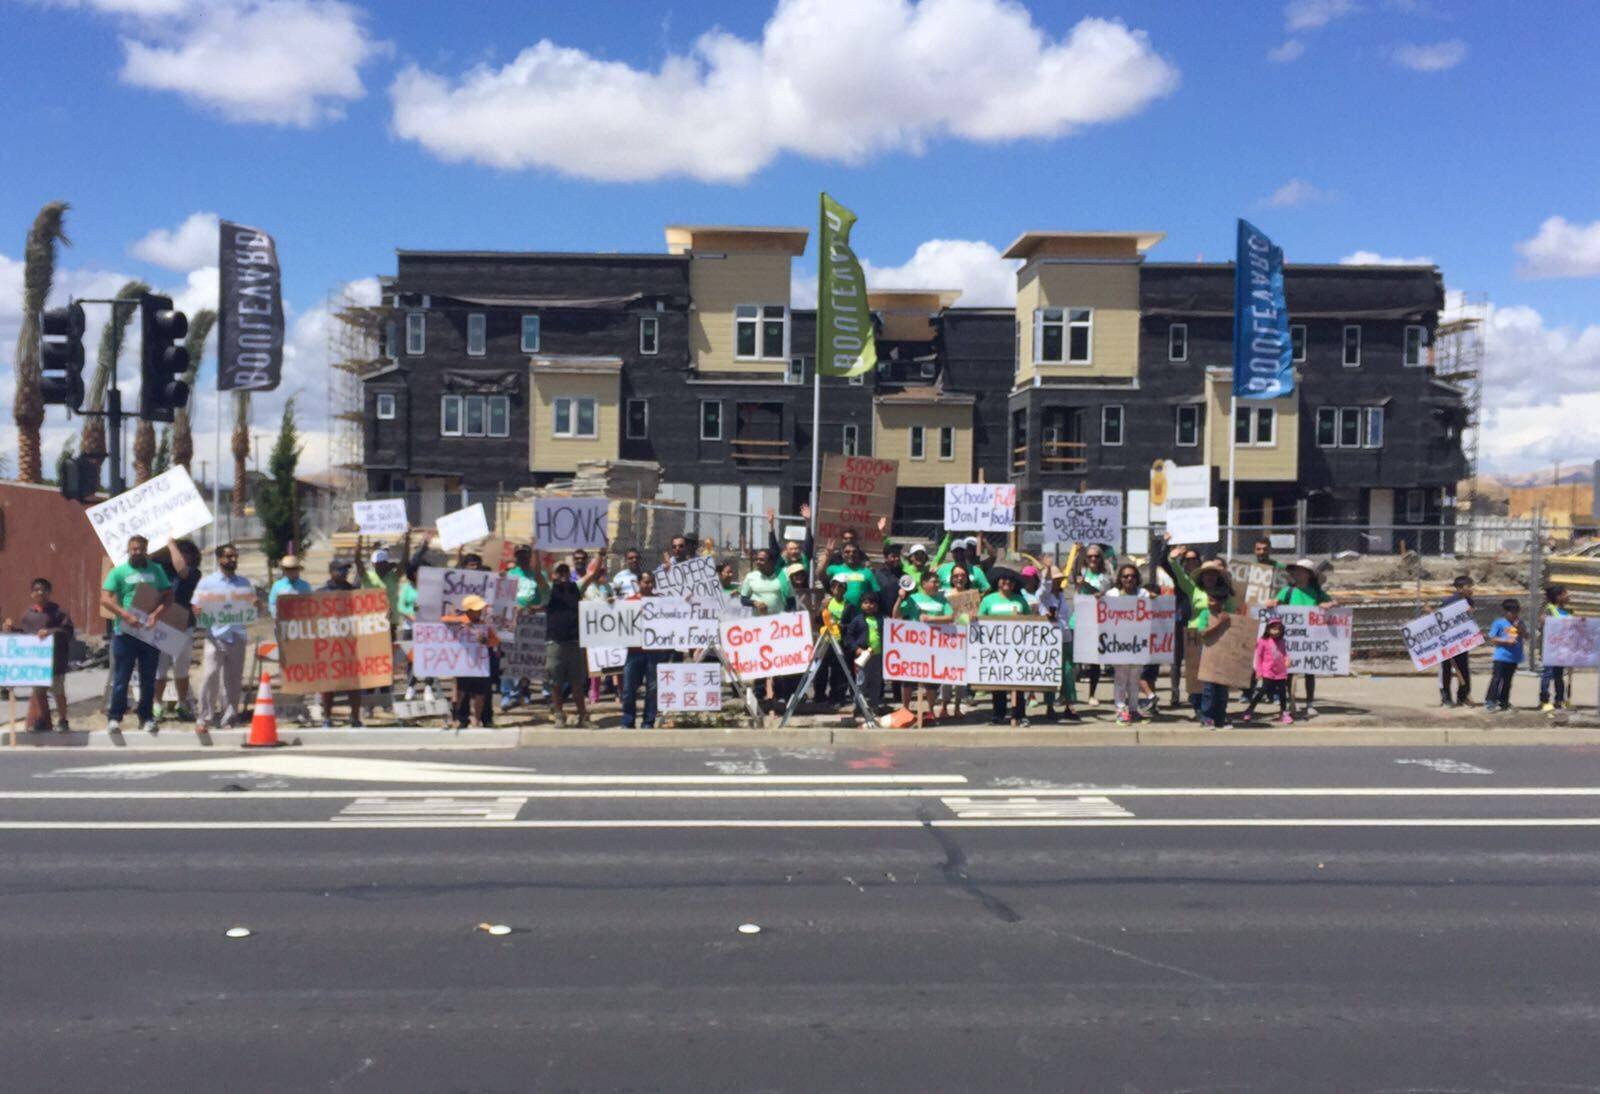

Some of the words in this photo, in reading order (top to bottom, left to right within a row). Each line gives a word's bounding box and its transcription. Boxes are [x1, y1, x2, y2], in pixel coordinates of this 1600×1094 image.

[839, 473, 875, 493] KIDS
[1048, 495, 1118, 508] DEVELOPERS
[1066, 508, 1093, 519] OWE
[535, 505, 609, 544] HONK
[1058, 528, 1114, 542] SCHOOLS
[322, 592, 388, 617] SCHOOLS
[279, 619, 315, 640] TOLL
[318, 612, 390, 637] BROTHERS
[586, 609, 643, 637] HONK
[770, 614, 804, 640] 2nd
[969, 624, 1061, 646] DEVELOPERS
[313, 638, 357, 659] PAY
[1286, 640, 1329, 652] UILDERS
[423, 646, 463, 671] PAY
[980, 648, 1008, 664] PAY
[1015, 648, 1060, 665] YOUR
[1304, 656, 1338, 671] MORE
[284, 661, 327, 683] YOUR
[332, 656, 392, 681] SHARES
[660, 670, 720, 686] 不买无
[979, 666, 1013, 682] FAIR
[1016, 666, 1062, 682] SHARE
[659, 692, 721, 707] 学区房
